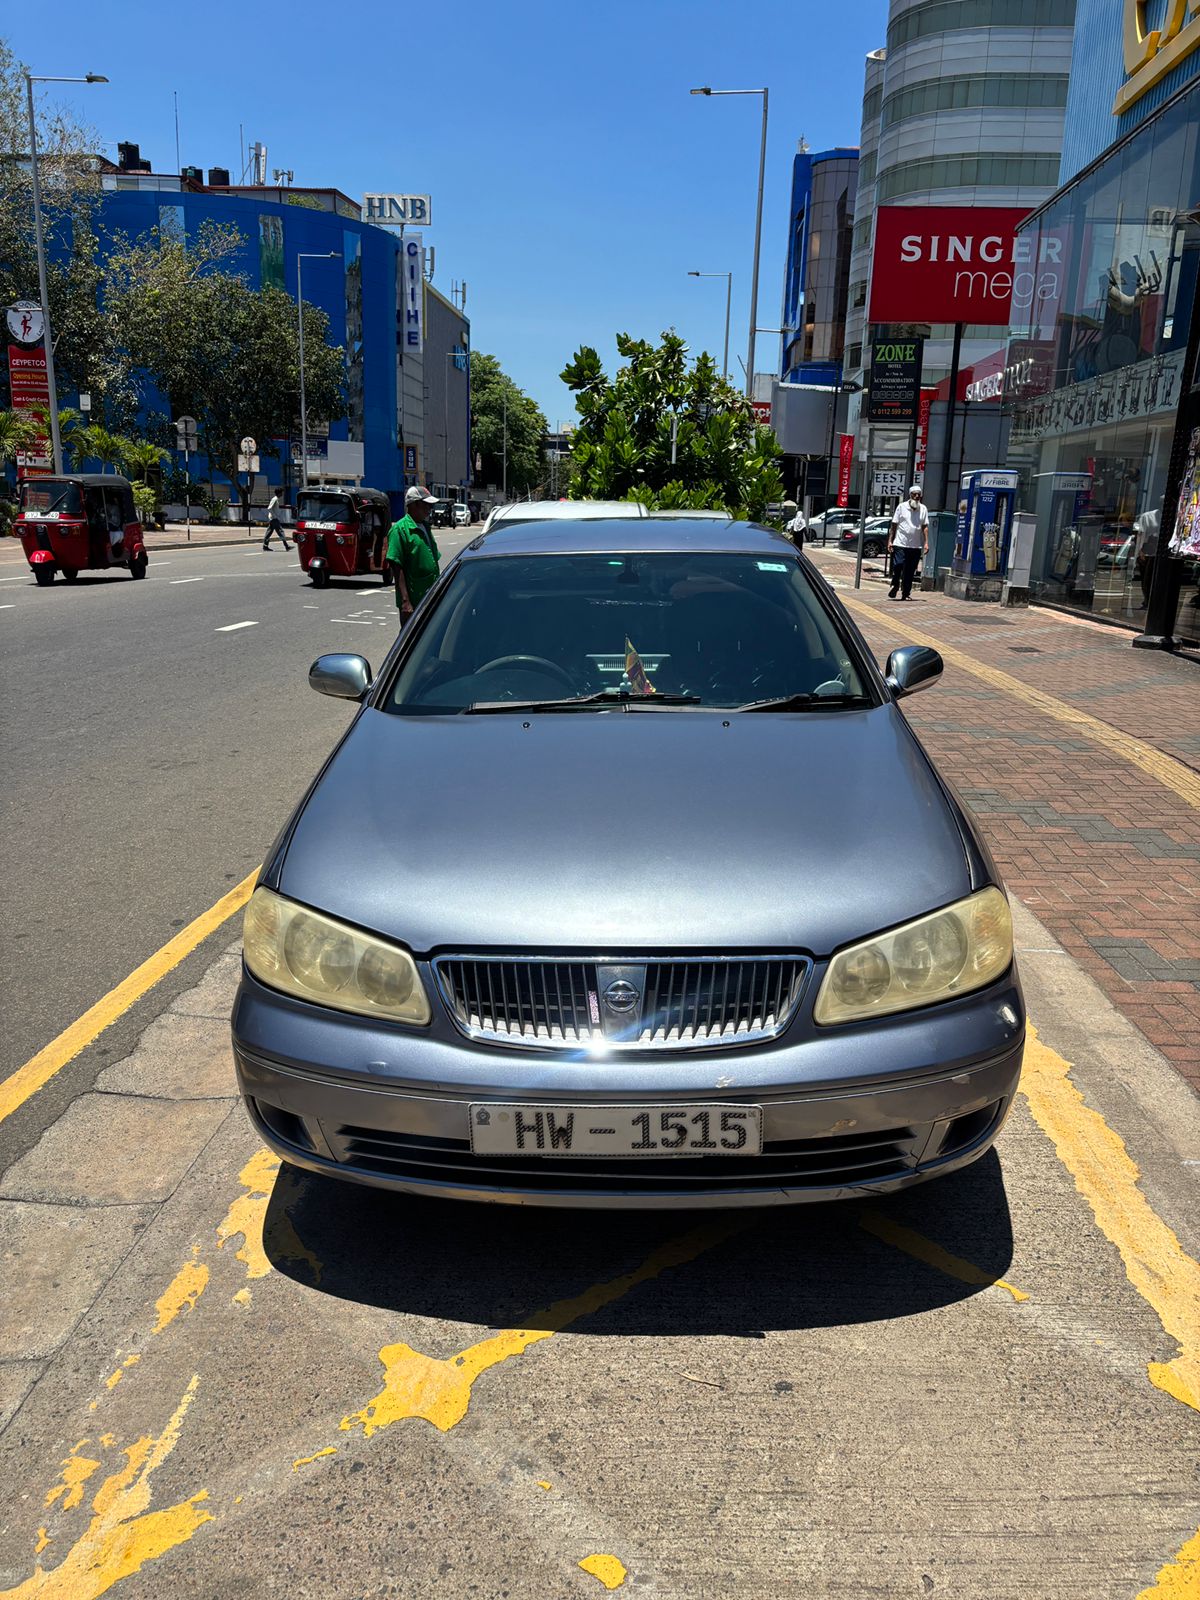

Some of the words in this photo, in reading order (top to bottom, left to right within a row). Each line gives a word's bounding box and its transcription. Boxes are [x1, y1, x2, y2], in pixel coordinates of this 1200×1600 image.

[366, 197, 427, 219] HNB
[900, 235, 1063, 263] SINGER
[953, 271, 1058, 308] mega
[12, 359, 46, 367] CEYPETCO
[875, 344, 916, 361] ZONE
[841, 467, 849, 503] SINGER
[515, 1111, 574, 1149] HW
[631, 1112, 747, 1149] 1515
